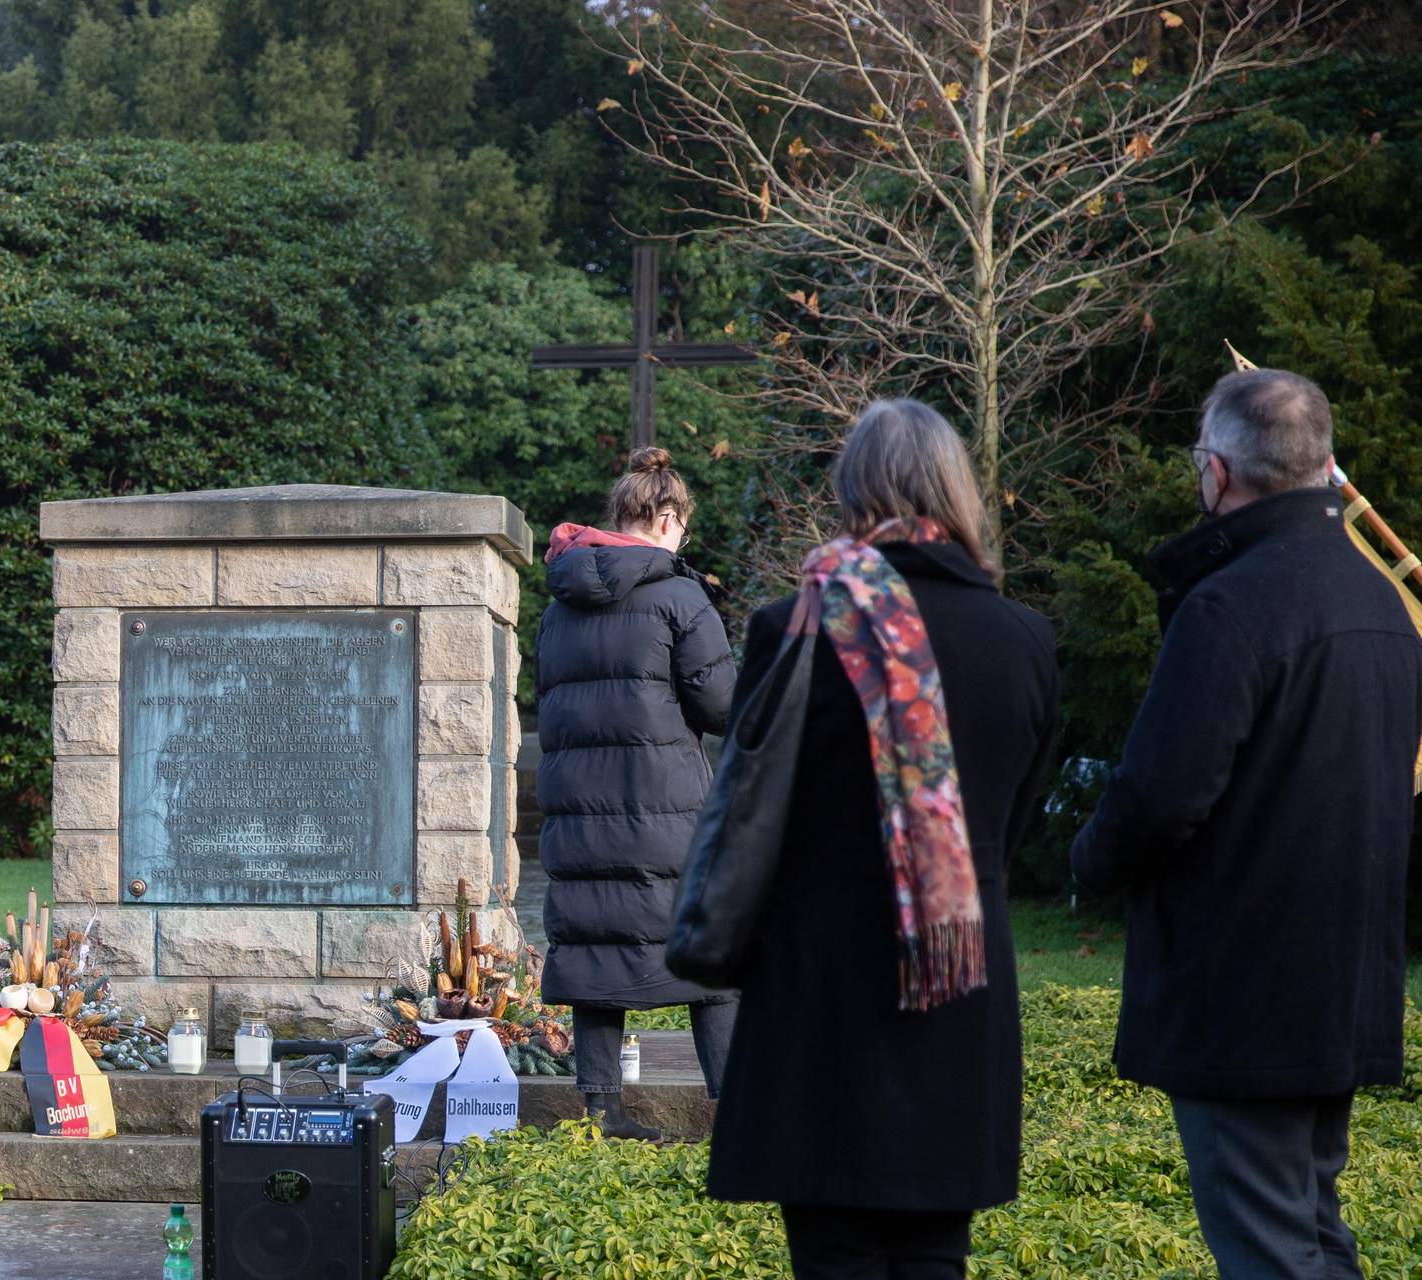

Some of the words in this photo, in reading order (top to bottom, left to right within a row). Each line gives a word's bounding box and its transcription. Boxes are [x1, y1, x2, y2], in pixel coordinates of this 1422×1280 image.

[154, 637, 177, 647] WER
[180, 637, 202, 647] VOR
[204, 637, 226, 647] DER
[228, 637, 322, 647] VERGANGENHEIT
[326, 637, 344, 647] DIE
[348, 637, 386, 647] AUGEN
[249, 646, 280, 656] WIRD
[337, 646, 370, 656] BLIND
[207, 656, 234, 665] FUER
[236, 656, 254, 665] DIE
[188, 670, 239, 680] RICHARD
[241, 670, 267, 680] VON
[269, 670, 348, 680] WEIZSAECKER
[224, 687, 247, 696] ZUM
[156, 696, 176, 705] DIE
[177, 696, 249, 705] NAMENTLICH
[252, 696, 326, 705] ERWAEHNTEN
[329, 696, 399, 705] GEFALLENEN
[204, 715, 242, 725] FIELEN
[244, 715, 278, 725] NICHT
[281, 715, 302, 725] ALS
[214, 725, 267, 734] SONDERN
[270, 725, 320, 734] STARBEN
[168, 735, 247, 744] ZERSCHOSSEN
[251, 735, 276, 744] UND
[212, 744, 318, 753] SCHLACHTFELDERN
[157, 761, 187, 770] DIESE
[190, 761, 227, 770] TOTEN
[228, 761, 271, 770] STEHEN
[273, 761, 377, 770] STELLVERTRETEND
[158, 770, 186, 779] FUER
[188, 770, 215, 779] ALLE
[218, 770, 255, 779] TOTEN
[257, 770, 278, 779] DER
[280, 770, 348, 779] WELTKRIEGE
[352, 770, 378, 779] VON
[252, 780, 277, 789] UND
[188, 790, 223, 799] SOWIE
[225, 790, 252, 799] FUER
[256, 790, 282, 799] ALLE
[285, 790, 320, 799] OPFER
[322, 790, 346, 799] VON
[166, 799, 293, 808] WILLKUERHERRSCHAFT
[296, 799, 321, 808] UND
[169, 815, 187, 825] IHR
[189, 815, 213, 825] TOD
[215, 815, 238, 825] HAT
[240, 815, 264, 825] NUR
[265, 815, 298, 825] DANN
[299, 815, 334, 825] EINEN
[208, 825, 239, 834] WENN
[241, 825, 265, 834] WIR
[179, 834, 208, 844] DASS
[210, 834, 262, 844] NIEMAND
[264, 834, 287, 844] DAS
[290, 834, 327, 844] RECHT
[180, 844, 223, 853] ANDERE
[226, 844, 287, 853] MENSCHEN
[244, 860, 262, 870] IHR
[264, 860, 288, 870] TOD
[151, 870, 179, 880] SOLL
[182, 870, 204, 880] UNS
[206, 870, 231, 880] EINE
[234, 870, 289, 880] BLEIBENDE
[291, 870, 351, 880] MAHNUNG
[447, 1098, 516, 1116] Dahlhausen
